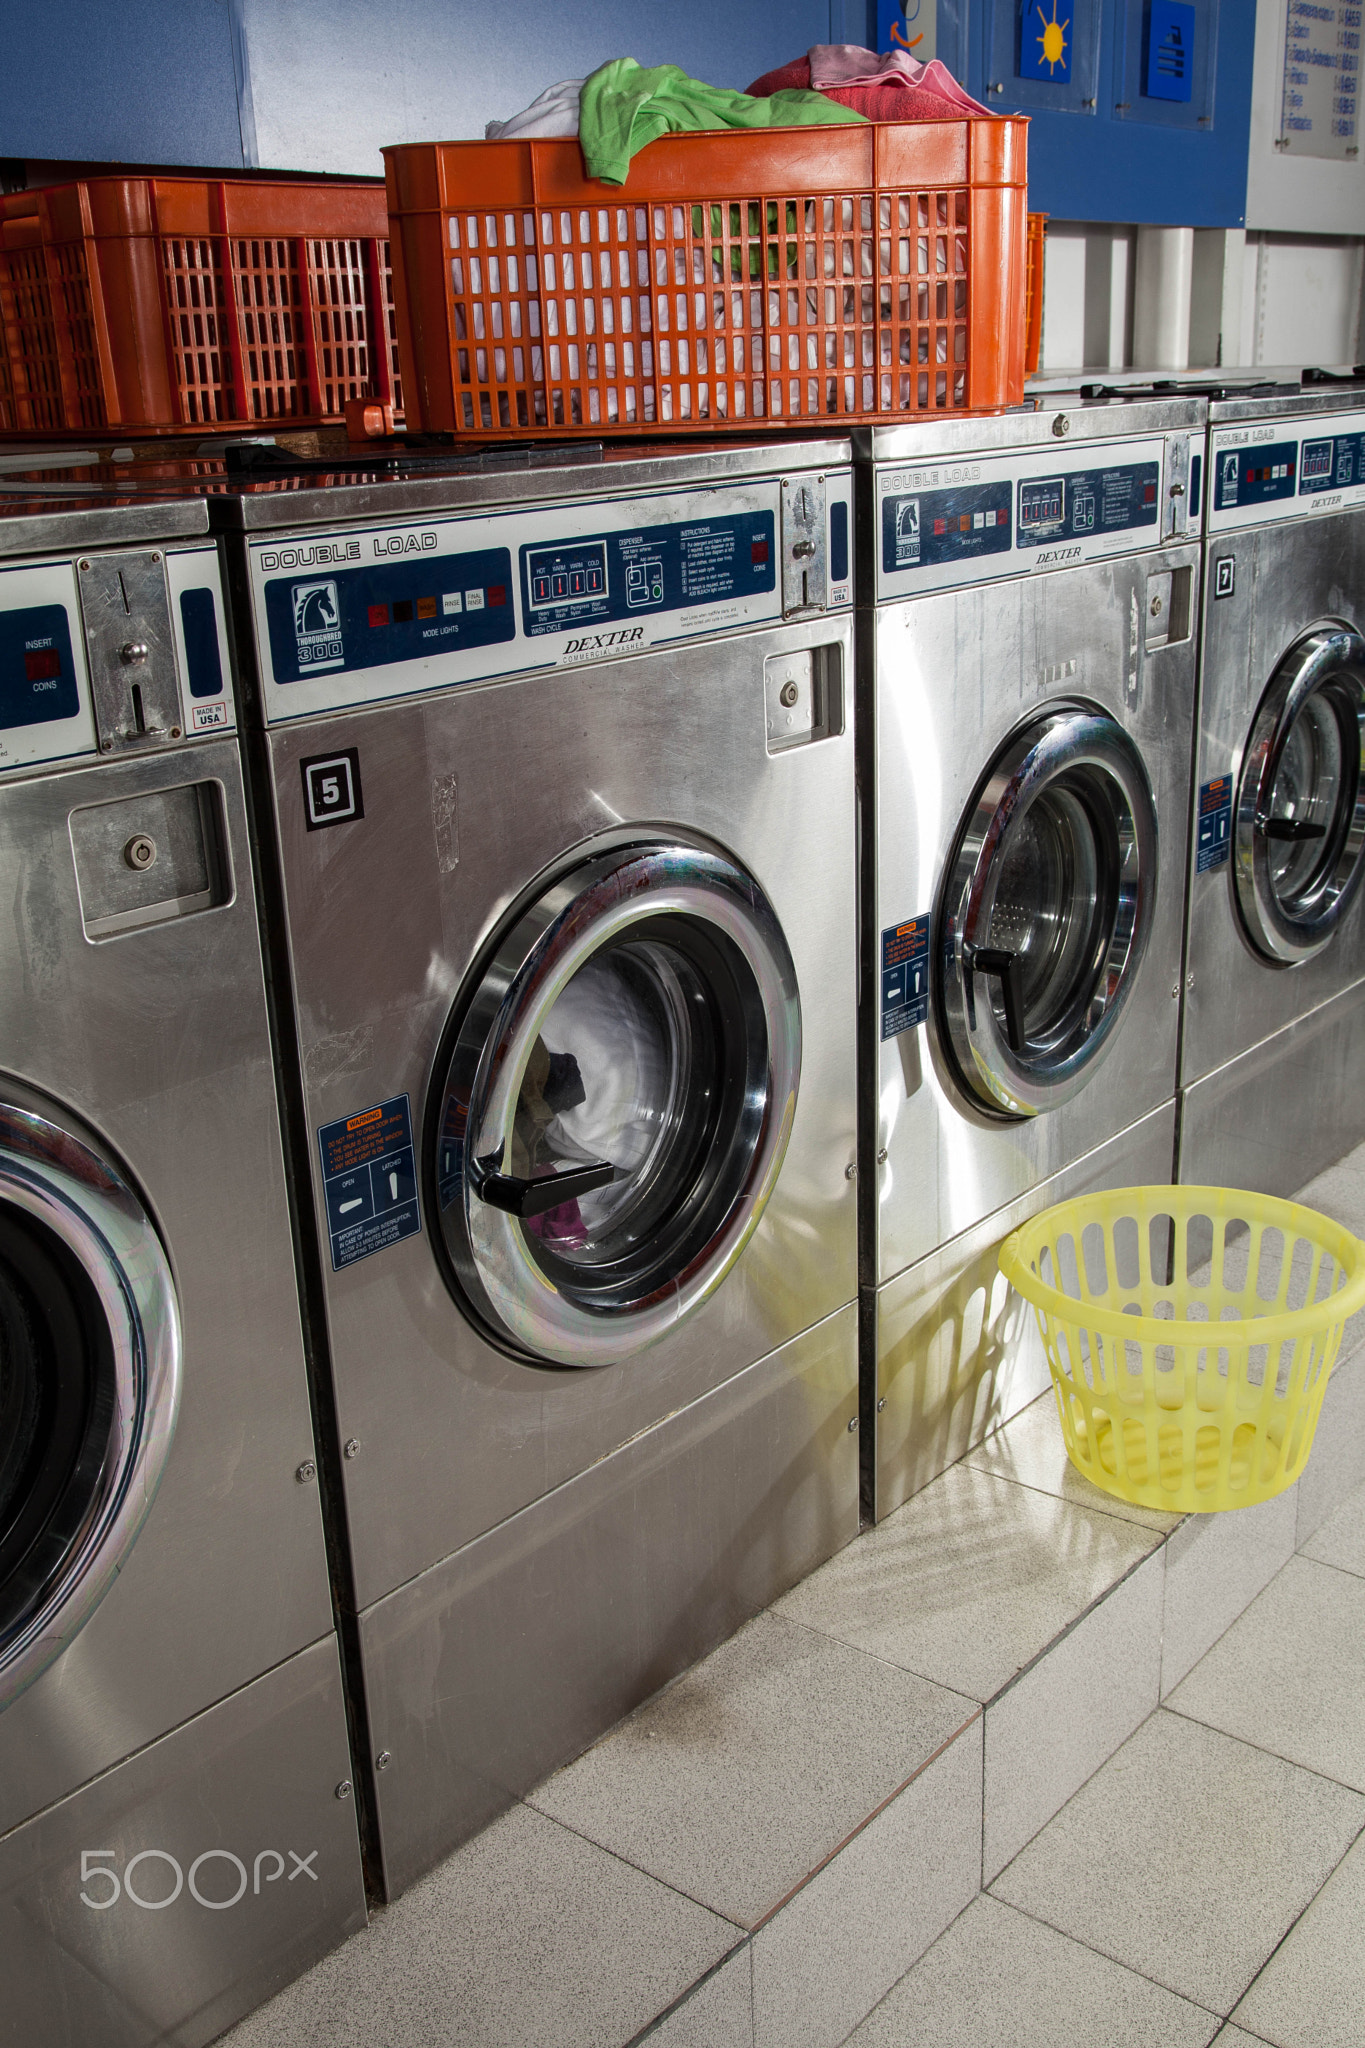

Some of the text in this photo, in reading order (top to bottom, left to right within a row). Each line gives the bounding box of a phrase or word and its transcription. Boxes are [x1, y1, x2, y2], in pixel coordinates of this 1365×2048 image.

[1216, 429, 1275, 446] DOUBLE LOAD
[881, 466, 981, 491] DOUBLE LOAD
[1311, 496, 1342, 508] DEXTER
[680, 526, 710, 537] INSTRUCTIONS
[619, 536, 643, 546] DISPENSER
[260, 532, 438, 572] DOUBLE LOAD
[896, 544, 920, 558] 300
[1036, 546, 1082, 564] DEXTER
[753, 564, 766, 572] COINS
[1221, 568, 1229, 586] 7
[422, 624, 459, 638] MODE LIGHTS
[531, 623, 562, 635] WASH CYCLE
[25, 637, 53, 650] INSERT
[296, 631, 342, 647] THOROUGHBRED
[563, 626, 644, 654] DEXTER
[298, 641, 344, 662] 300
[563, 642, 644, 663] COMMERCIAL WASHER
[33, 680, 57, 692] COINS
[196, 707, 214, 715] MADE
[200, 714, 220, 724] USA
[322, 777, 339, 805] 5
[349, 1111, 380, 1129] WARNING
[336, 1136, 345, 1146] NOT
[363, 1125, 375, 1135] OPEN
[376, 1120, 388, 1129] DOOR
[362, 1132, 381, 1143] TURNING
[334, 1154, 343, 1162] YOU
[344, 1151, 353, 1159] SEE
[335, 1162, 344, 1170] ANY
[359, 1151, 370, 1160] LIGHT
[381, 1158, 402, 1171] LATCHED
[342, 1178, 355, 1188] OPEN
[340, 1246, 355, 1255] ALLOW
[363, 1234, 381, 1245] MINUTES
[382, 1224, 399, 1236] BEFORE
[345, 1237, 356, 1246] CASE
[364, 1226, 380, 1237] POWER
[340, 1246, 367, 1263] ATTEMPTING
[375, 1236, 387, 1246] OPEN
